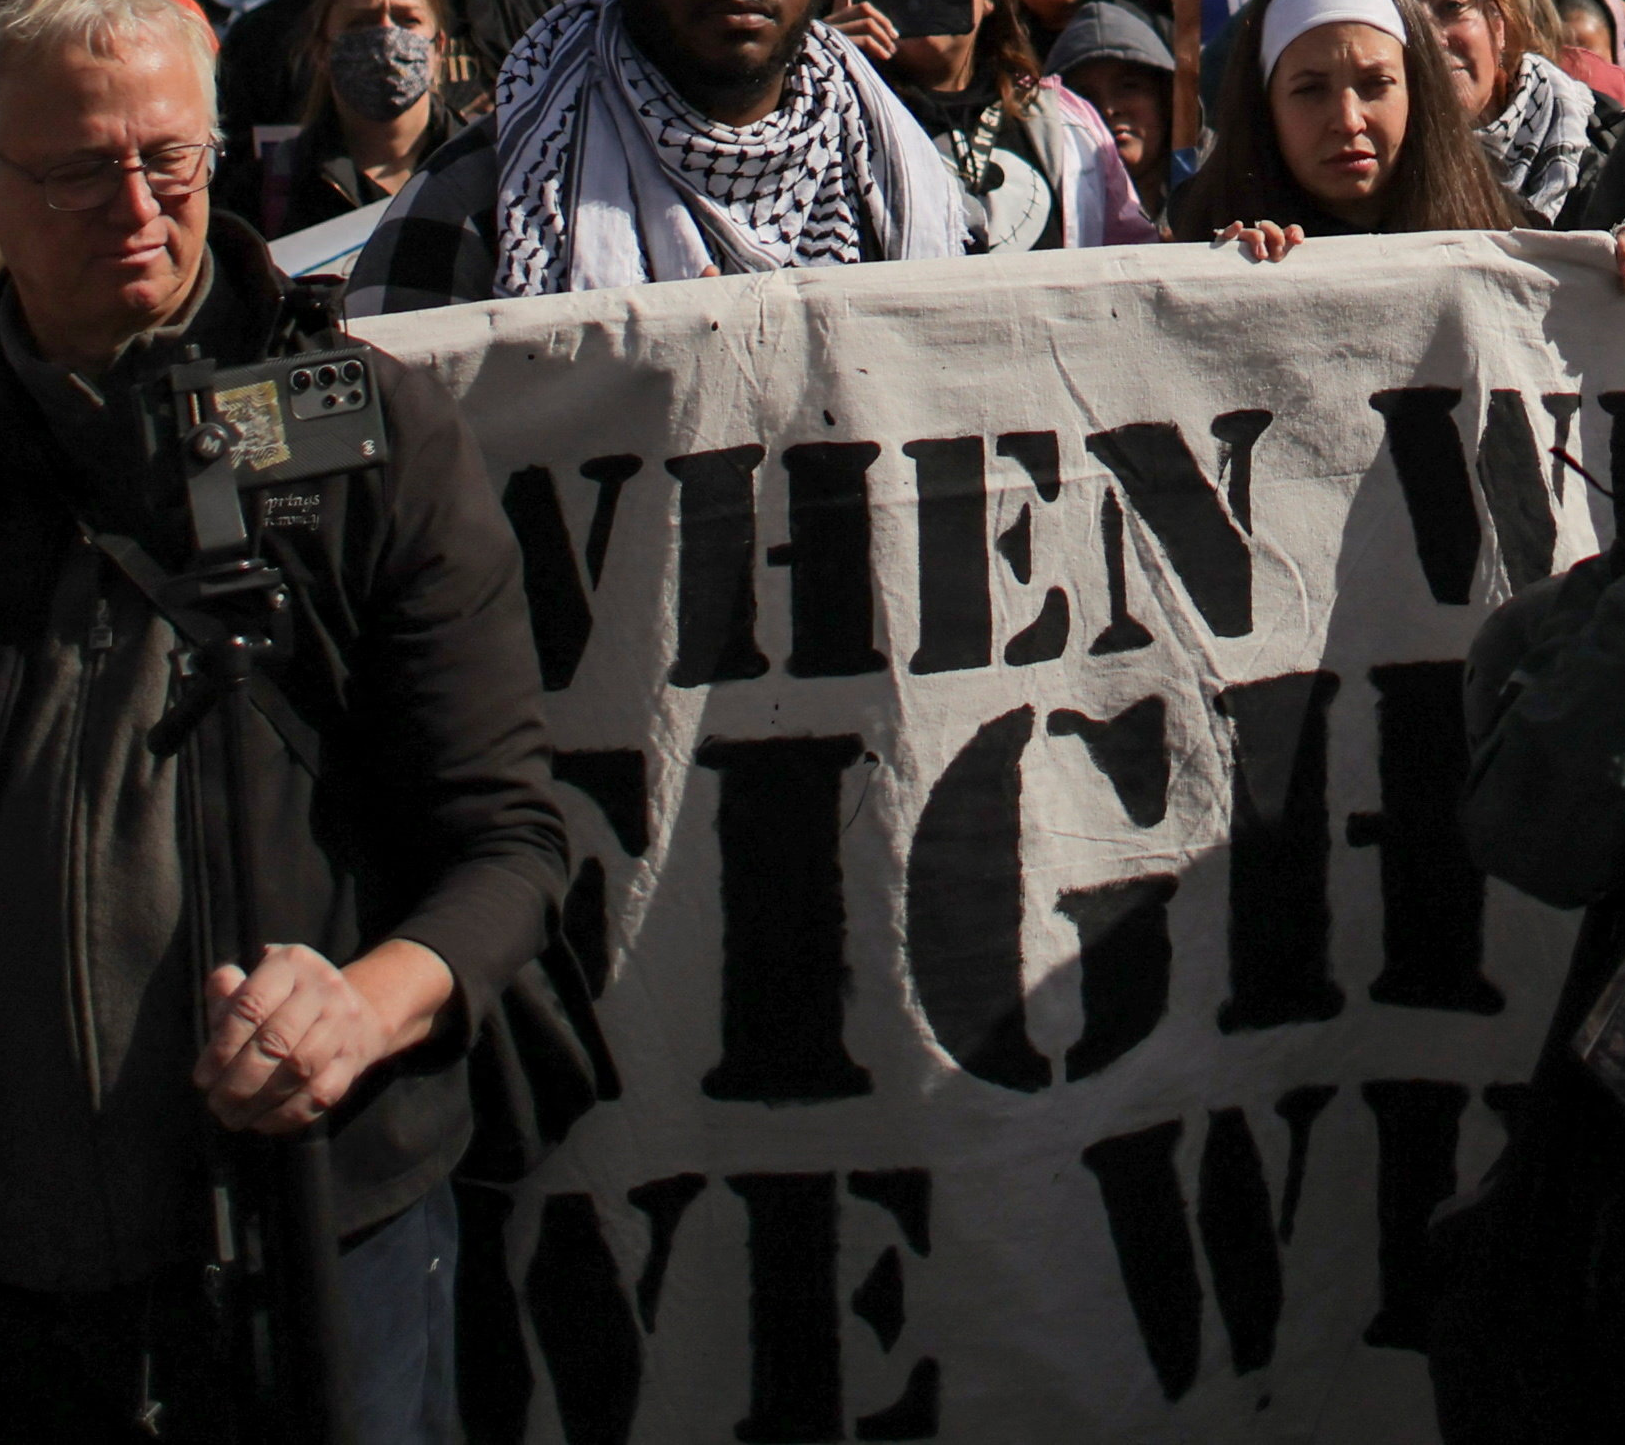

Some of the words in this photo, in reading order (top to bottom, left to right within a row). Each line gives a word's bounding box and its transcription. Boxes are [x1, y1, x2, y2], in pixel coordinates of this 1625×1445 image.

[502, 407, 1275, 692] WHEN
[455, 1167, 941, 1443] WE
[1080, 1079, 1535, 1405] WI
